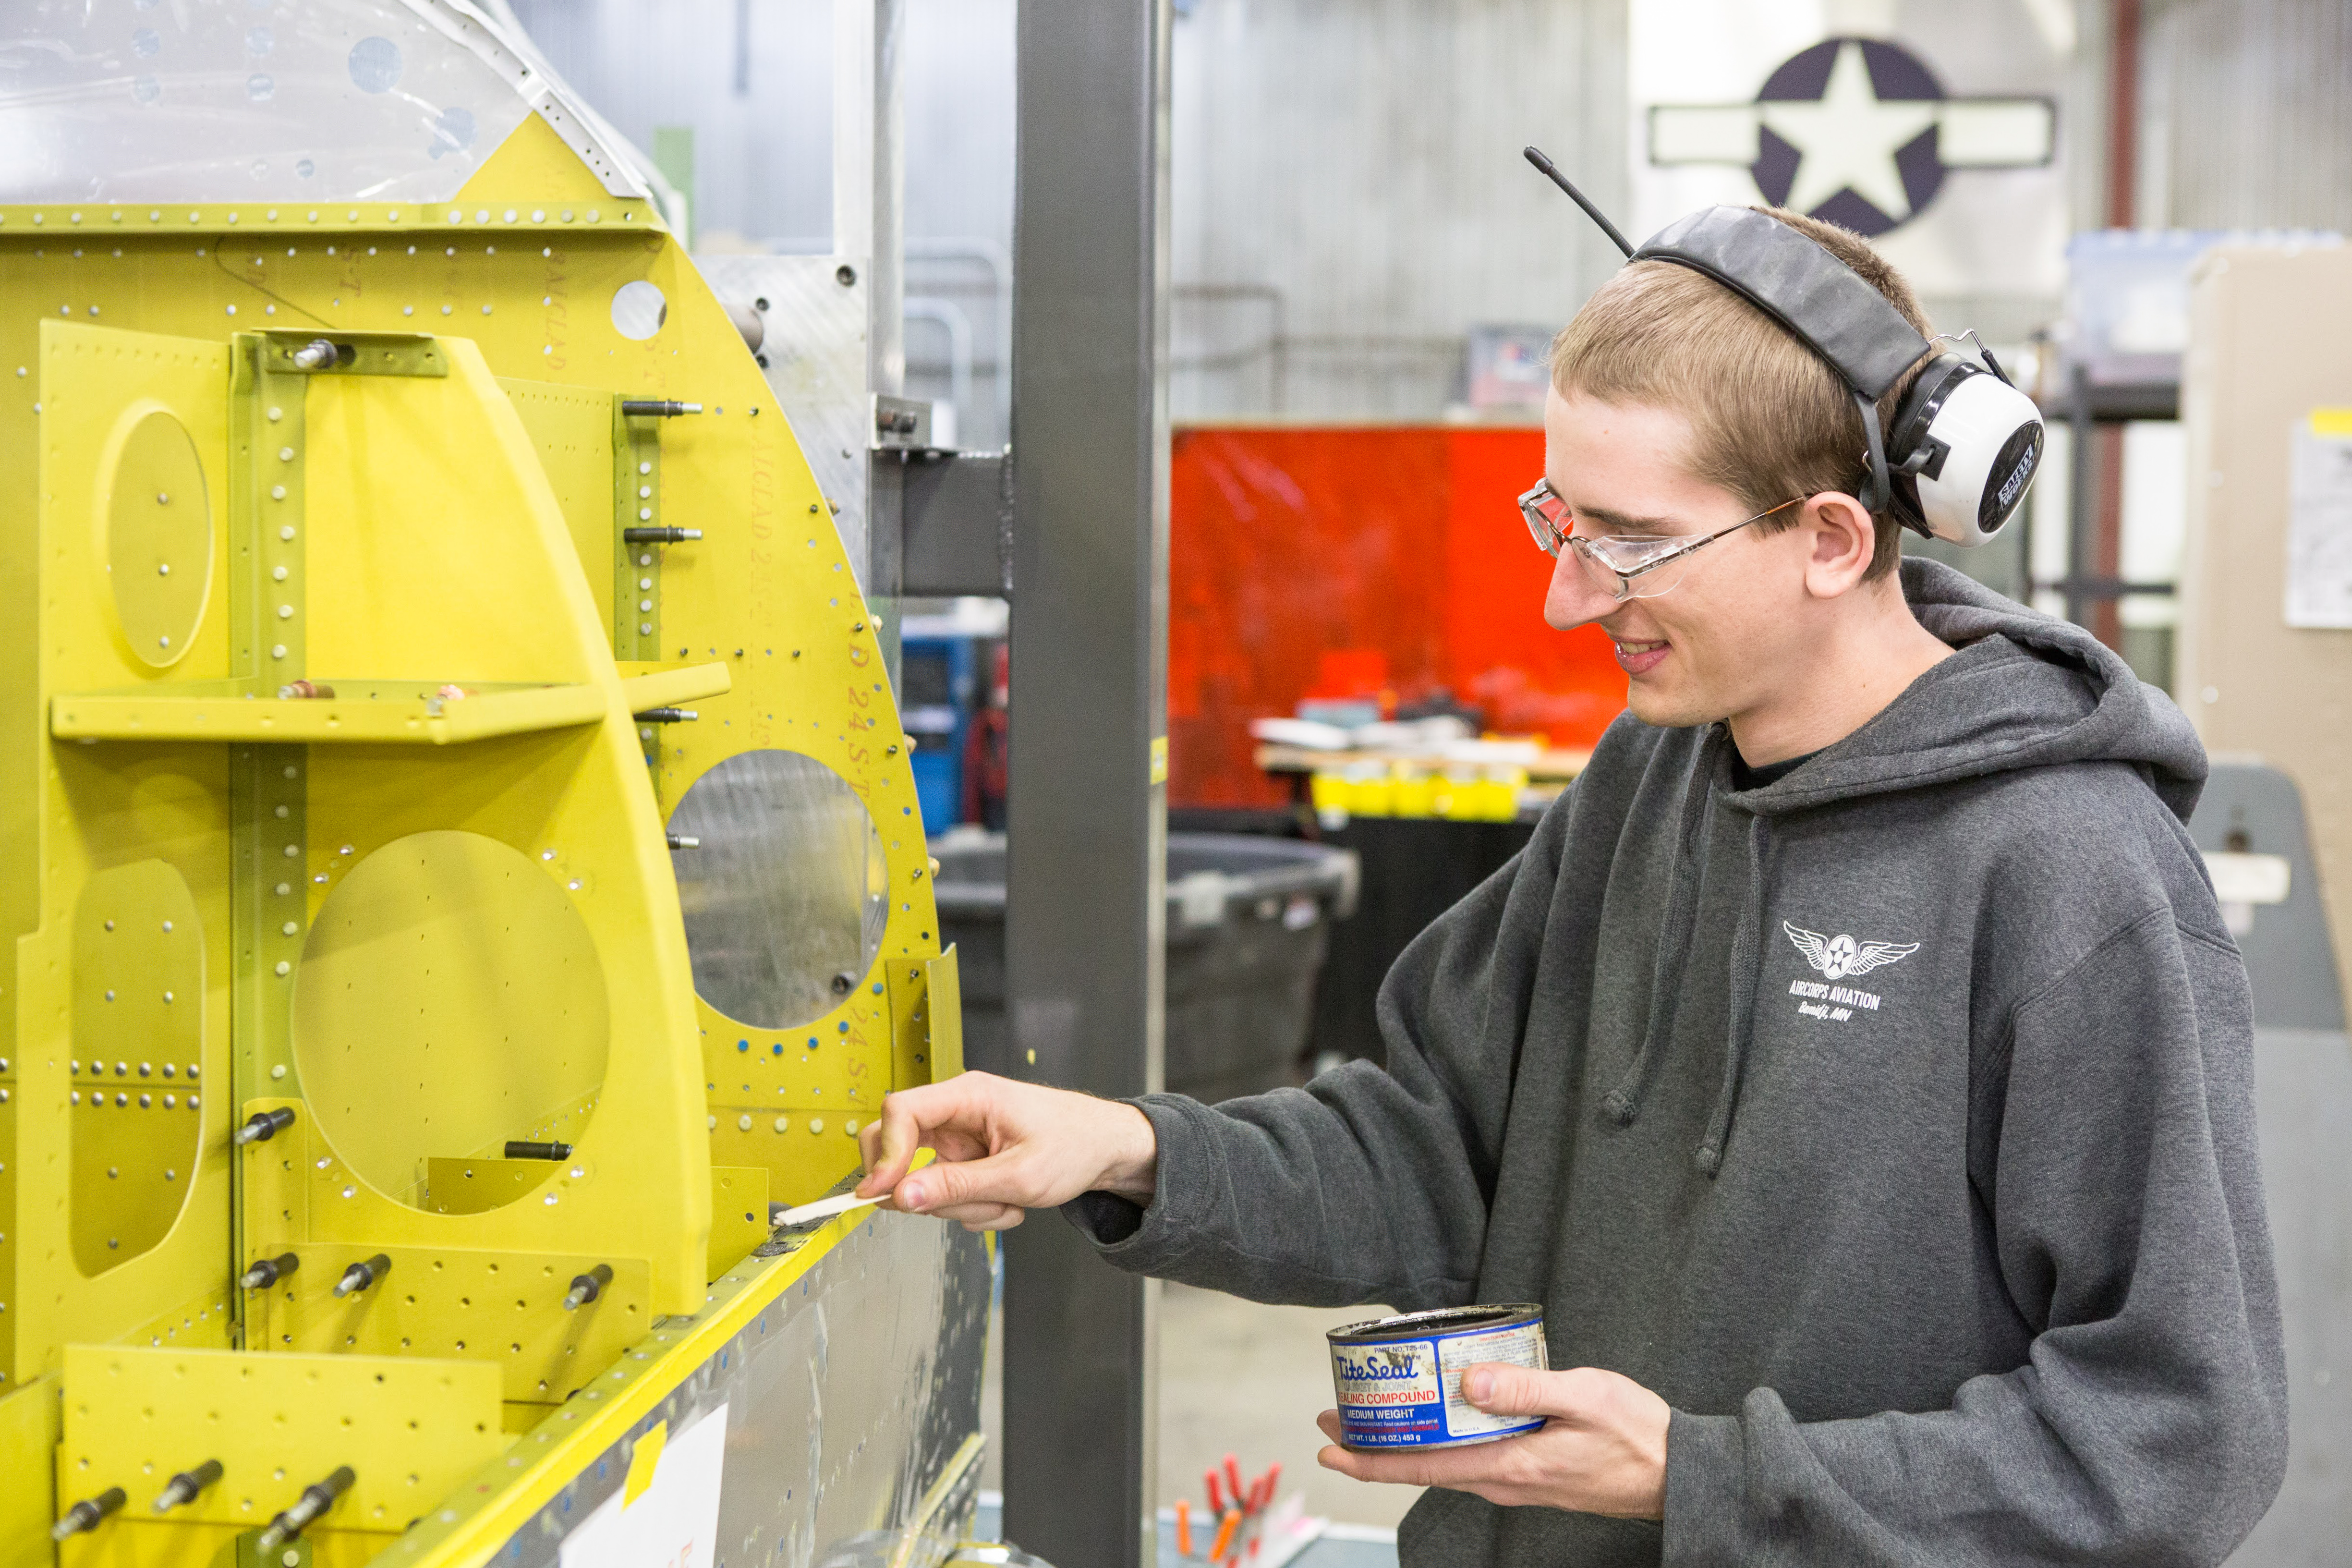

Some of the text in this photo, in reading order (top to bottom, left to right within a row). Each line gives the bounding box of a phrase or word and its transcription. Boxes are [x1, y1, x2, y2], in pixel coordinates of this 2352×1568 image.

[2001, 449, 2031, 498] SAFETY
[2003, 460, 2033, 506] WORKS
[1789, 980, 1881, 1011] AIRCORPS AVIATION
[1829, 1007, 1853, 1022] MN
[1373, 1381, 1381, 1392] &
[1382, 1380, 1412, 1391] JOINT
[1367, 1390, 1436, 1404] COMPOUND
[1346, 1408, 1415, 1419] MEDIUM WEIGHT
[1388, 1434, 1401, 1443] OZ.)
